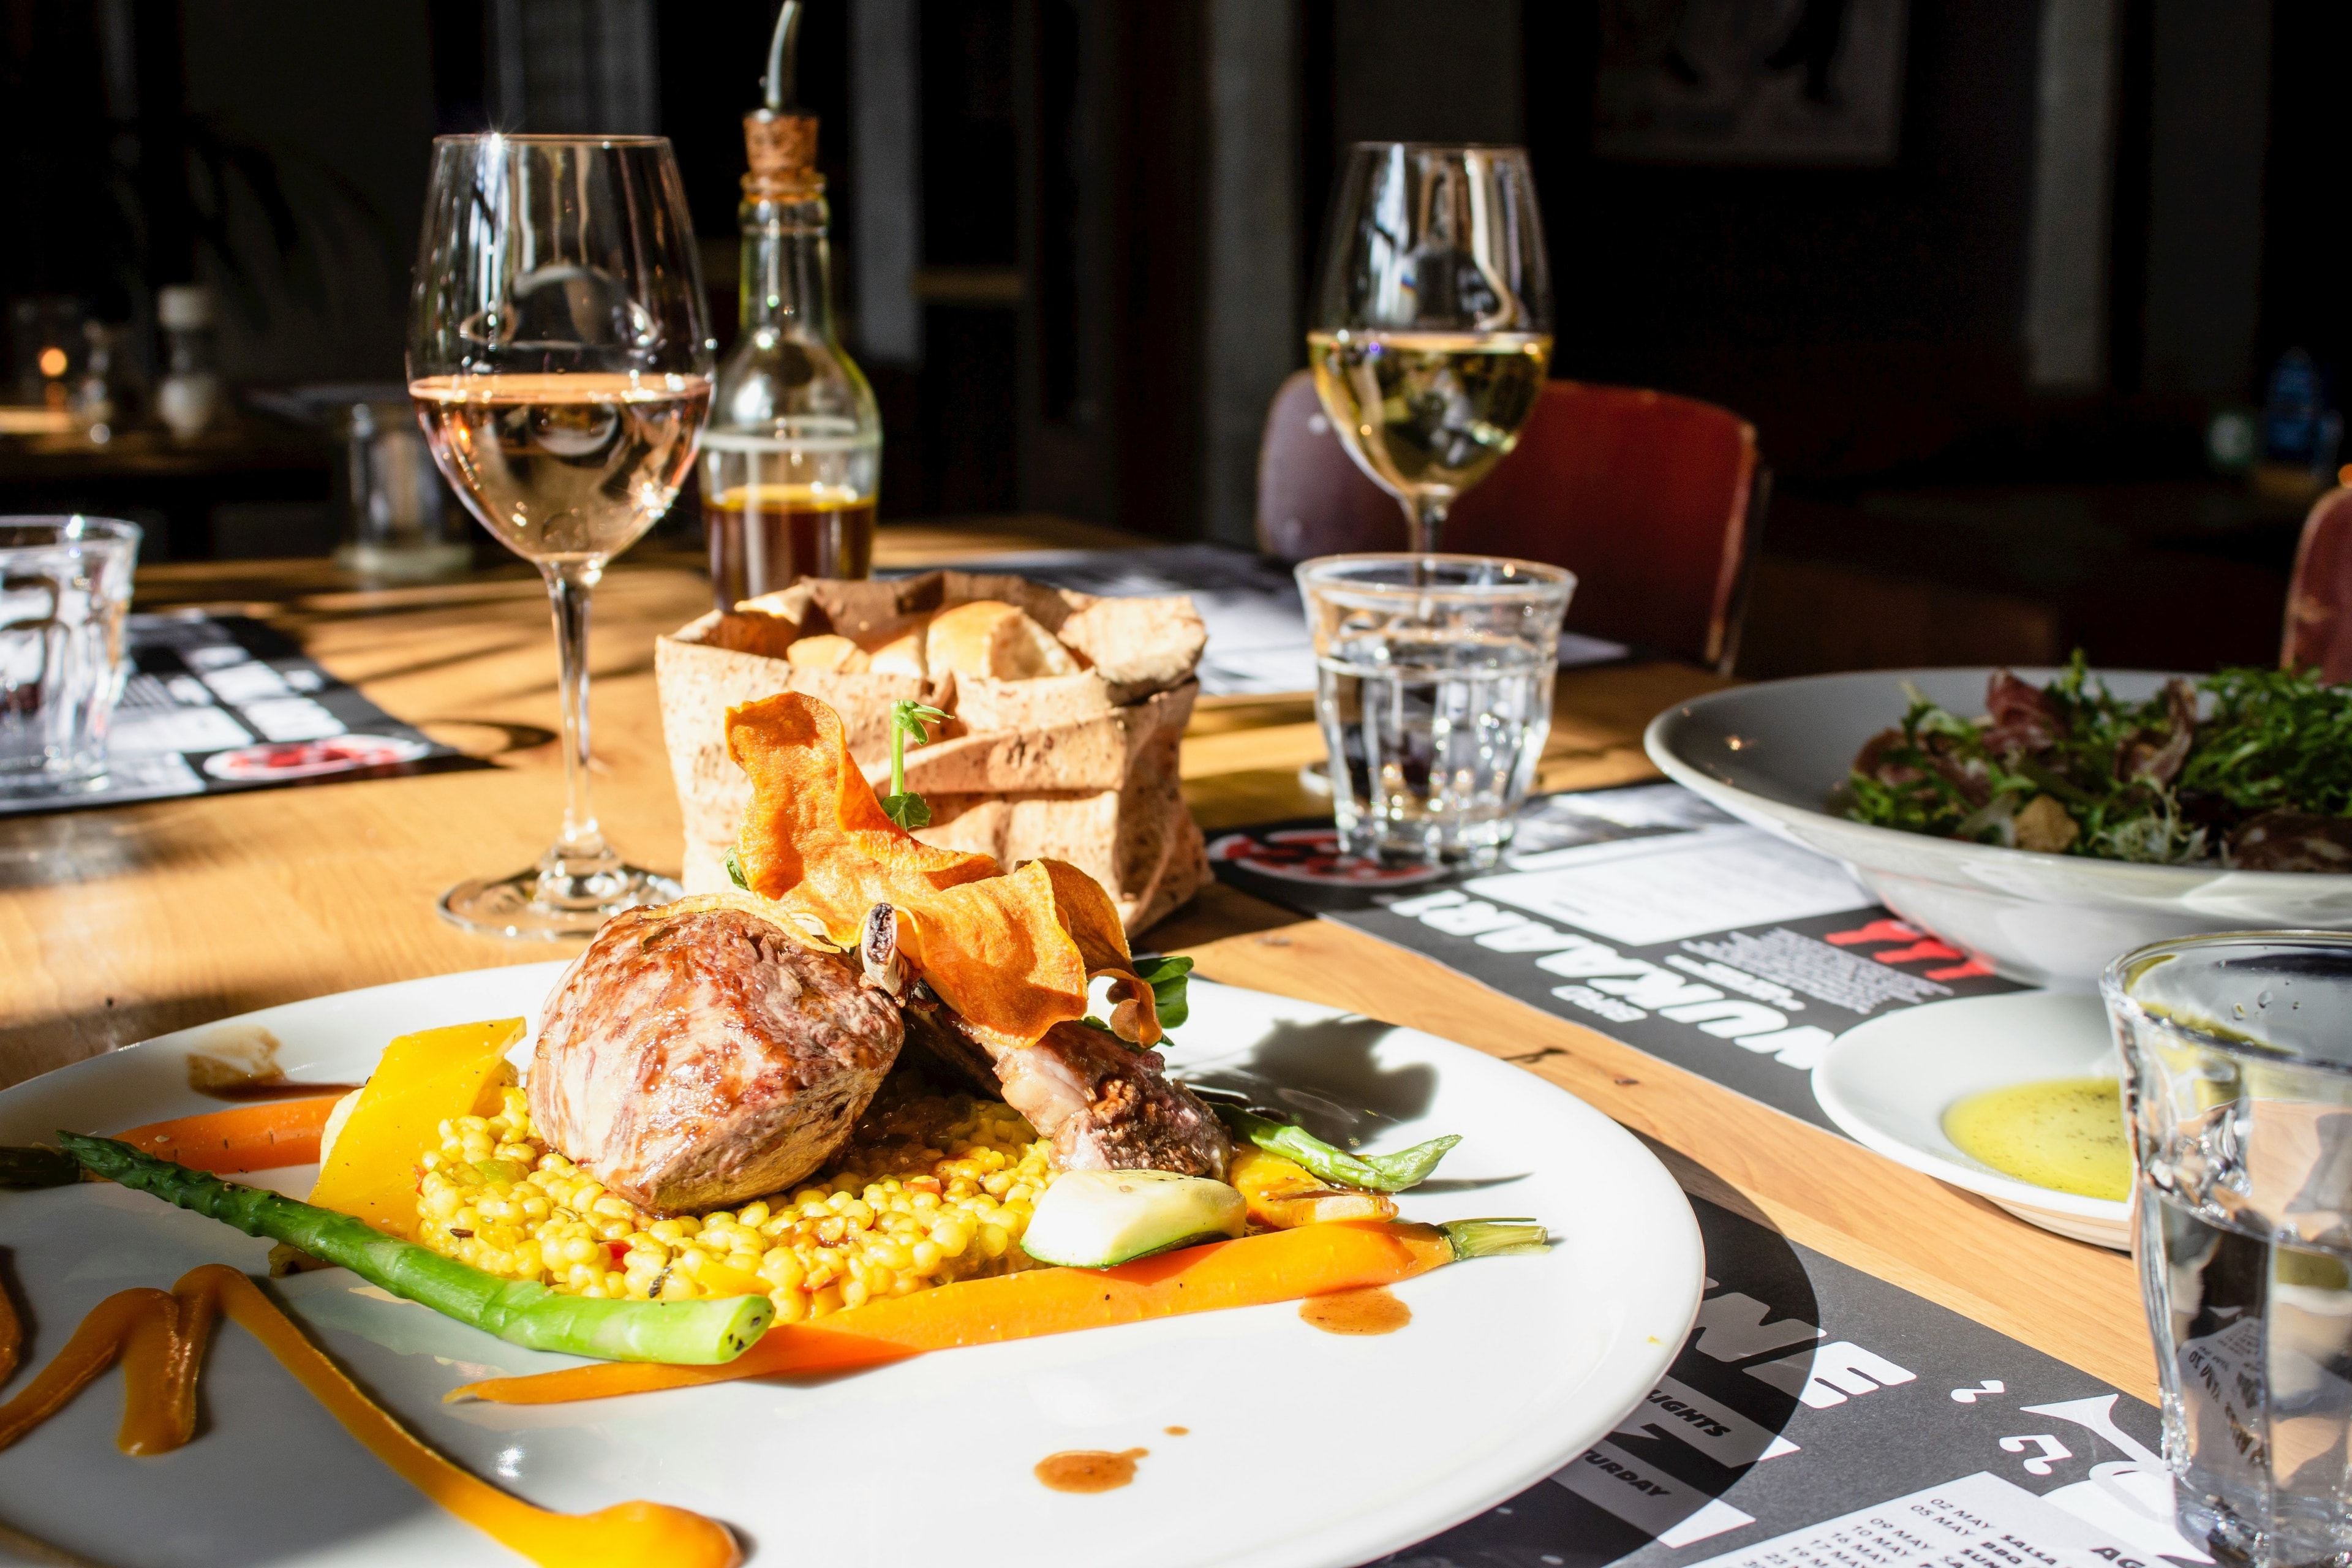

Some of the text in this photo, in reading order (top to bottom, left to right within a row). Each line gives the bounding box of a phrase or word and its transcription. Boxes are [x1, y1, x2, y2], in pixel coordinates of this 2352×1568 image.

[1810, 1539, 1831, 1550] 17
[1852, 1525, 1915, 1557] 10 MAY
[1892, 1530, 1935, 1550] MAY
[1910, 1505, 2022, 1565] 05 MAY BBQ
[1931, 1499, 2057, 1566] 02 MAY SALSA
[1850, 1544, 1895, 1564] MAY
